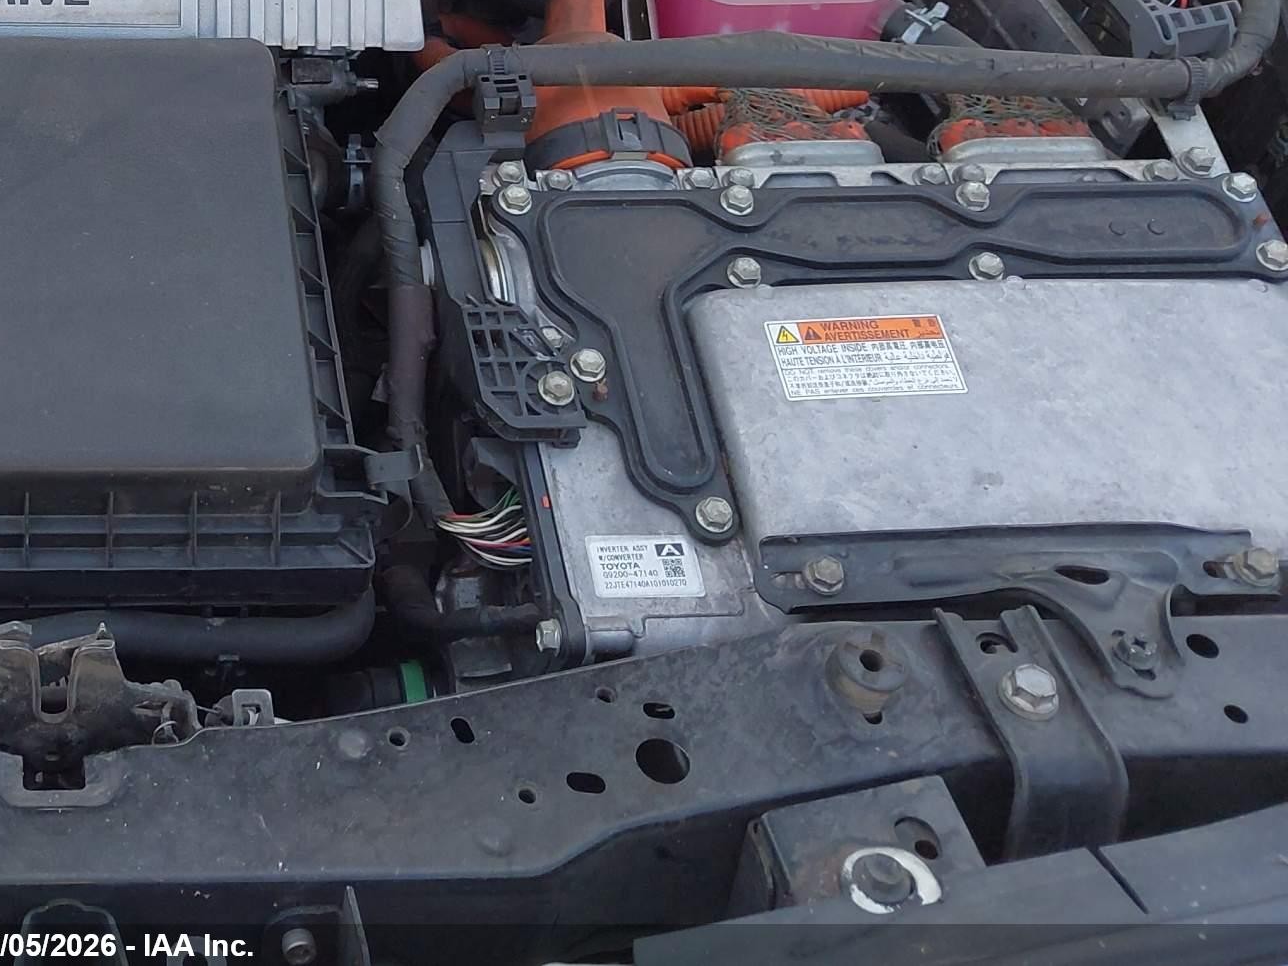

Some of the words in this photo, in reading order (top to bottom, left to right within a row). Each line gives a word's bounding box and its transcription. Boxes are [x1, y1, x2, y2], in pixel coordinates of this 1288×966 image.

[821, 321, 879, 331] WARNING
[825, 329, 911, 341] AVERTISSEMENT
[778, 345, 797, 356] HIGH
[802, 344, 838, 354] VOLTAGE
[841, 343, 868, 352] INSIDE
[781, 356, 804, 367] HAUTE
[805, 354, 834, 366] TENSION
[597, 545, 629, 553] INVERTER
[599, 553, 644, 561] W/CONVERTER
[600, 562, 641, 571] TOYOTA
